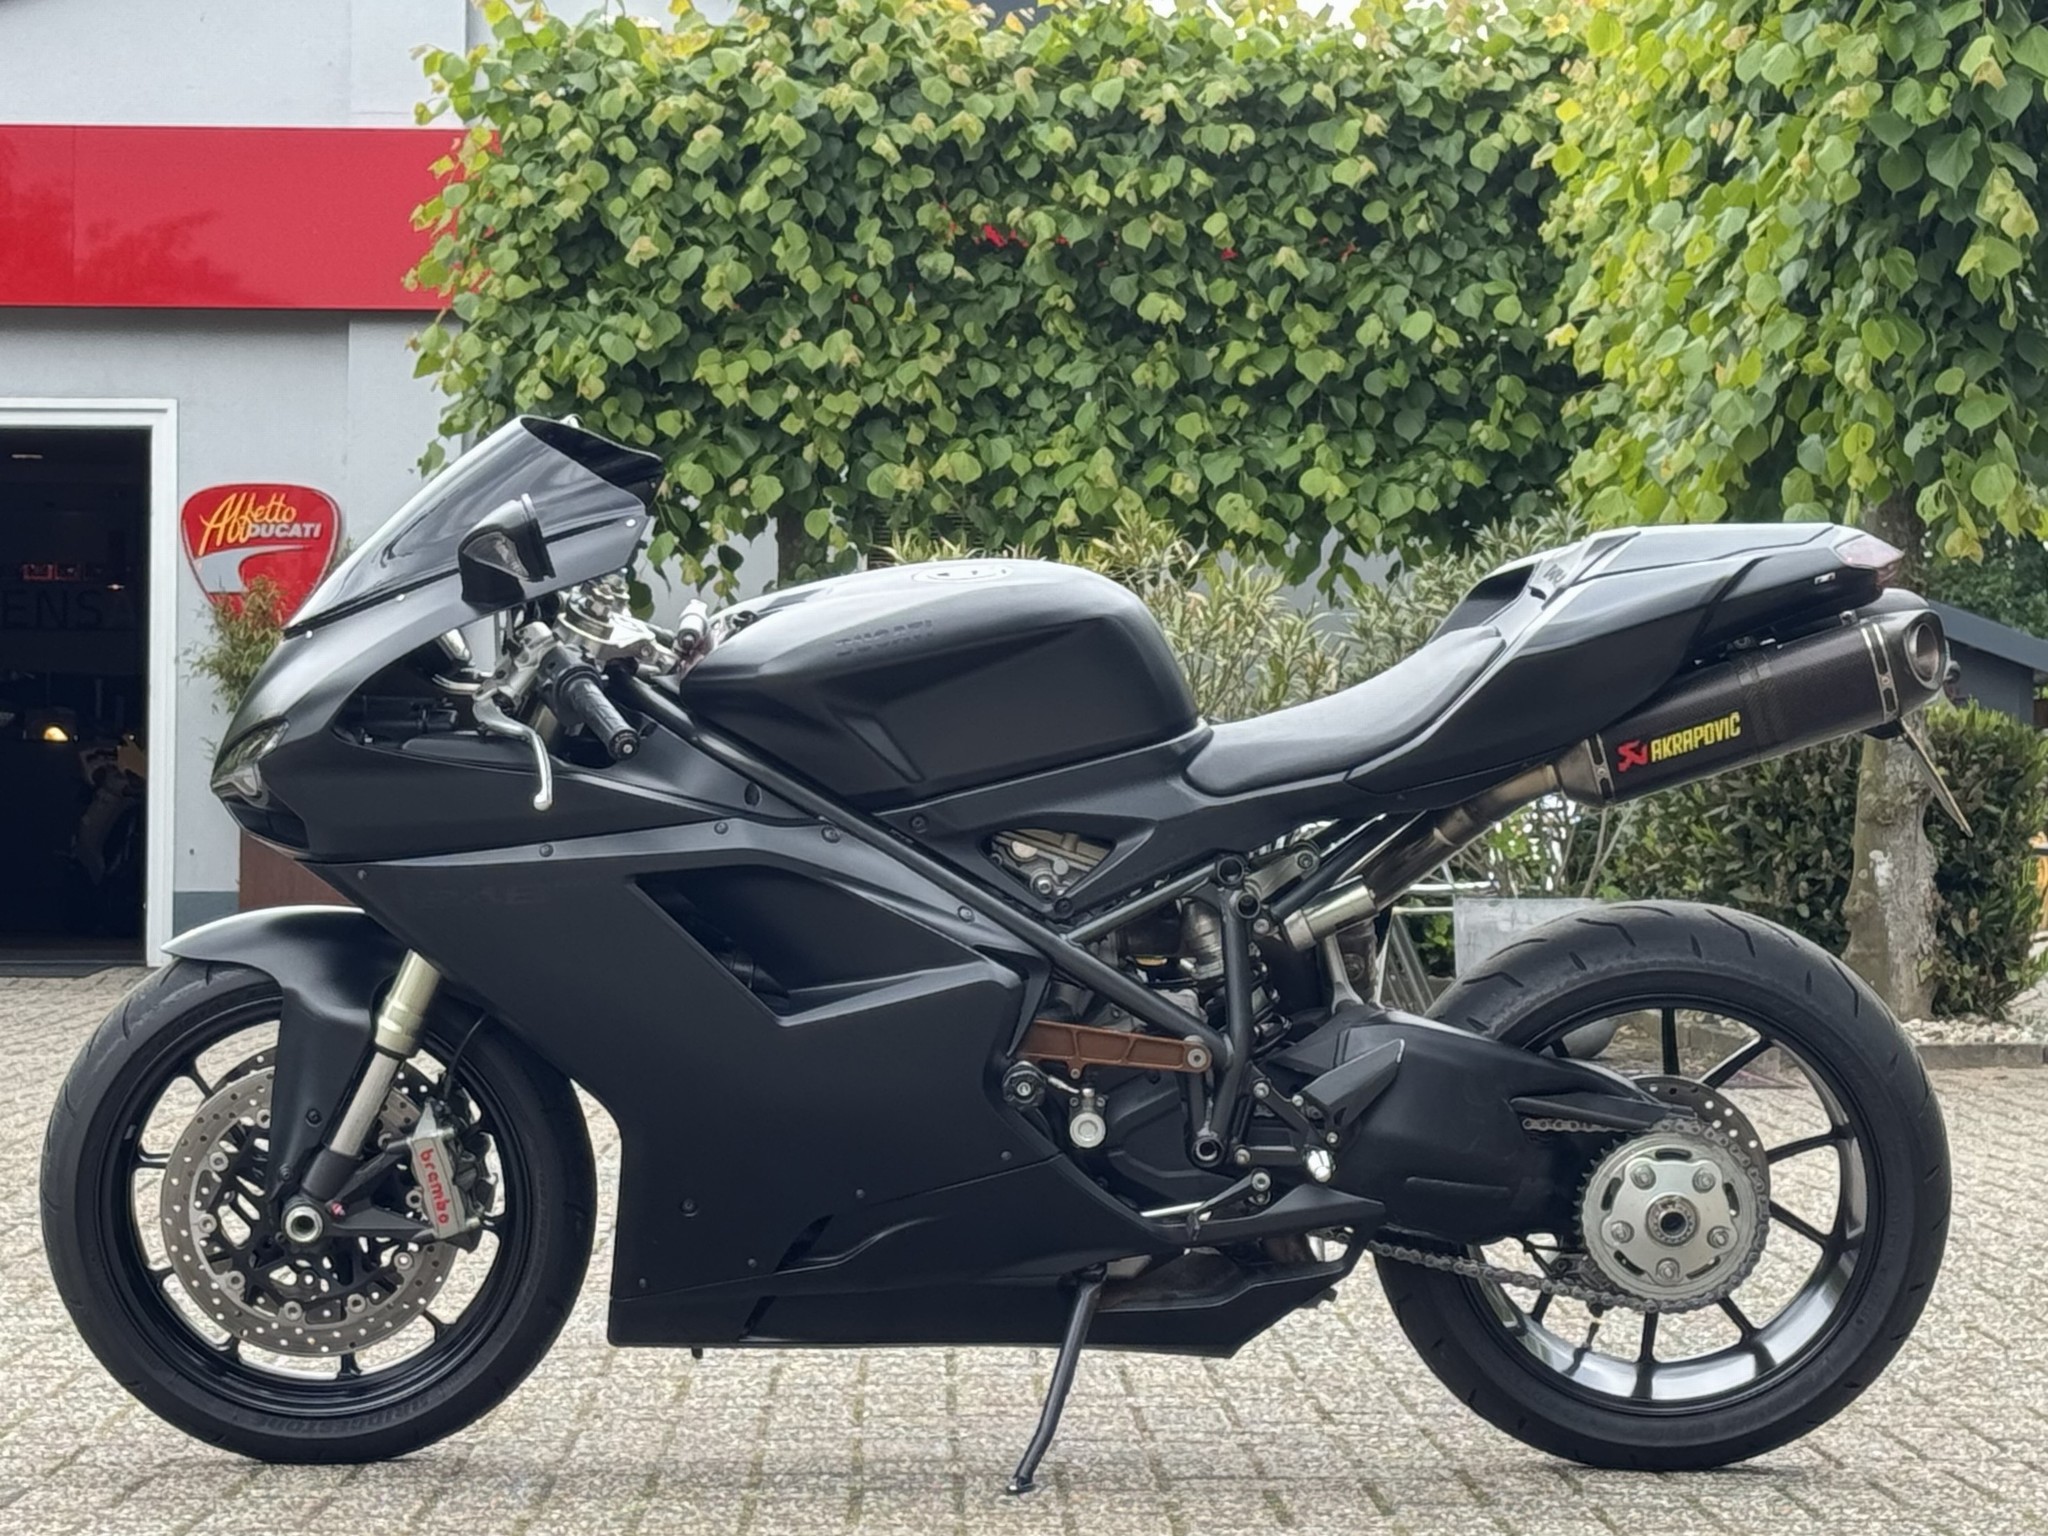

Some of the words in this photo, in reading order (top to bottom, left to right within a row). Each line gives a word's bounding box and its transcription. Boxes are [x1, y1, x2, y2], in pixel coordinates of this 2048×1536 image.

[199, 492, 296, 555] Affetto
[249, 522, 322, 539] DUCATI
[835, 618, 933, 657] DUCATI
[420, 1148, 450, 1224] brembo
